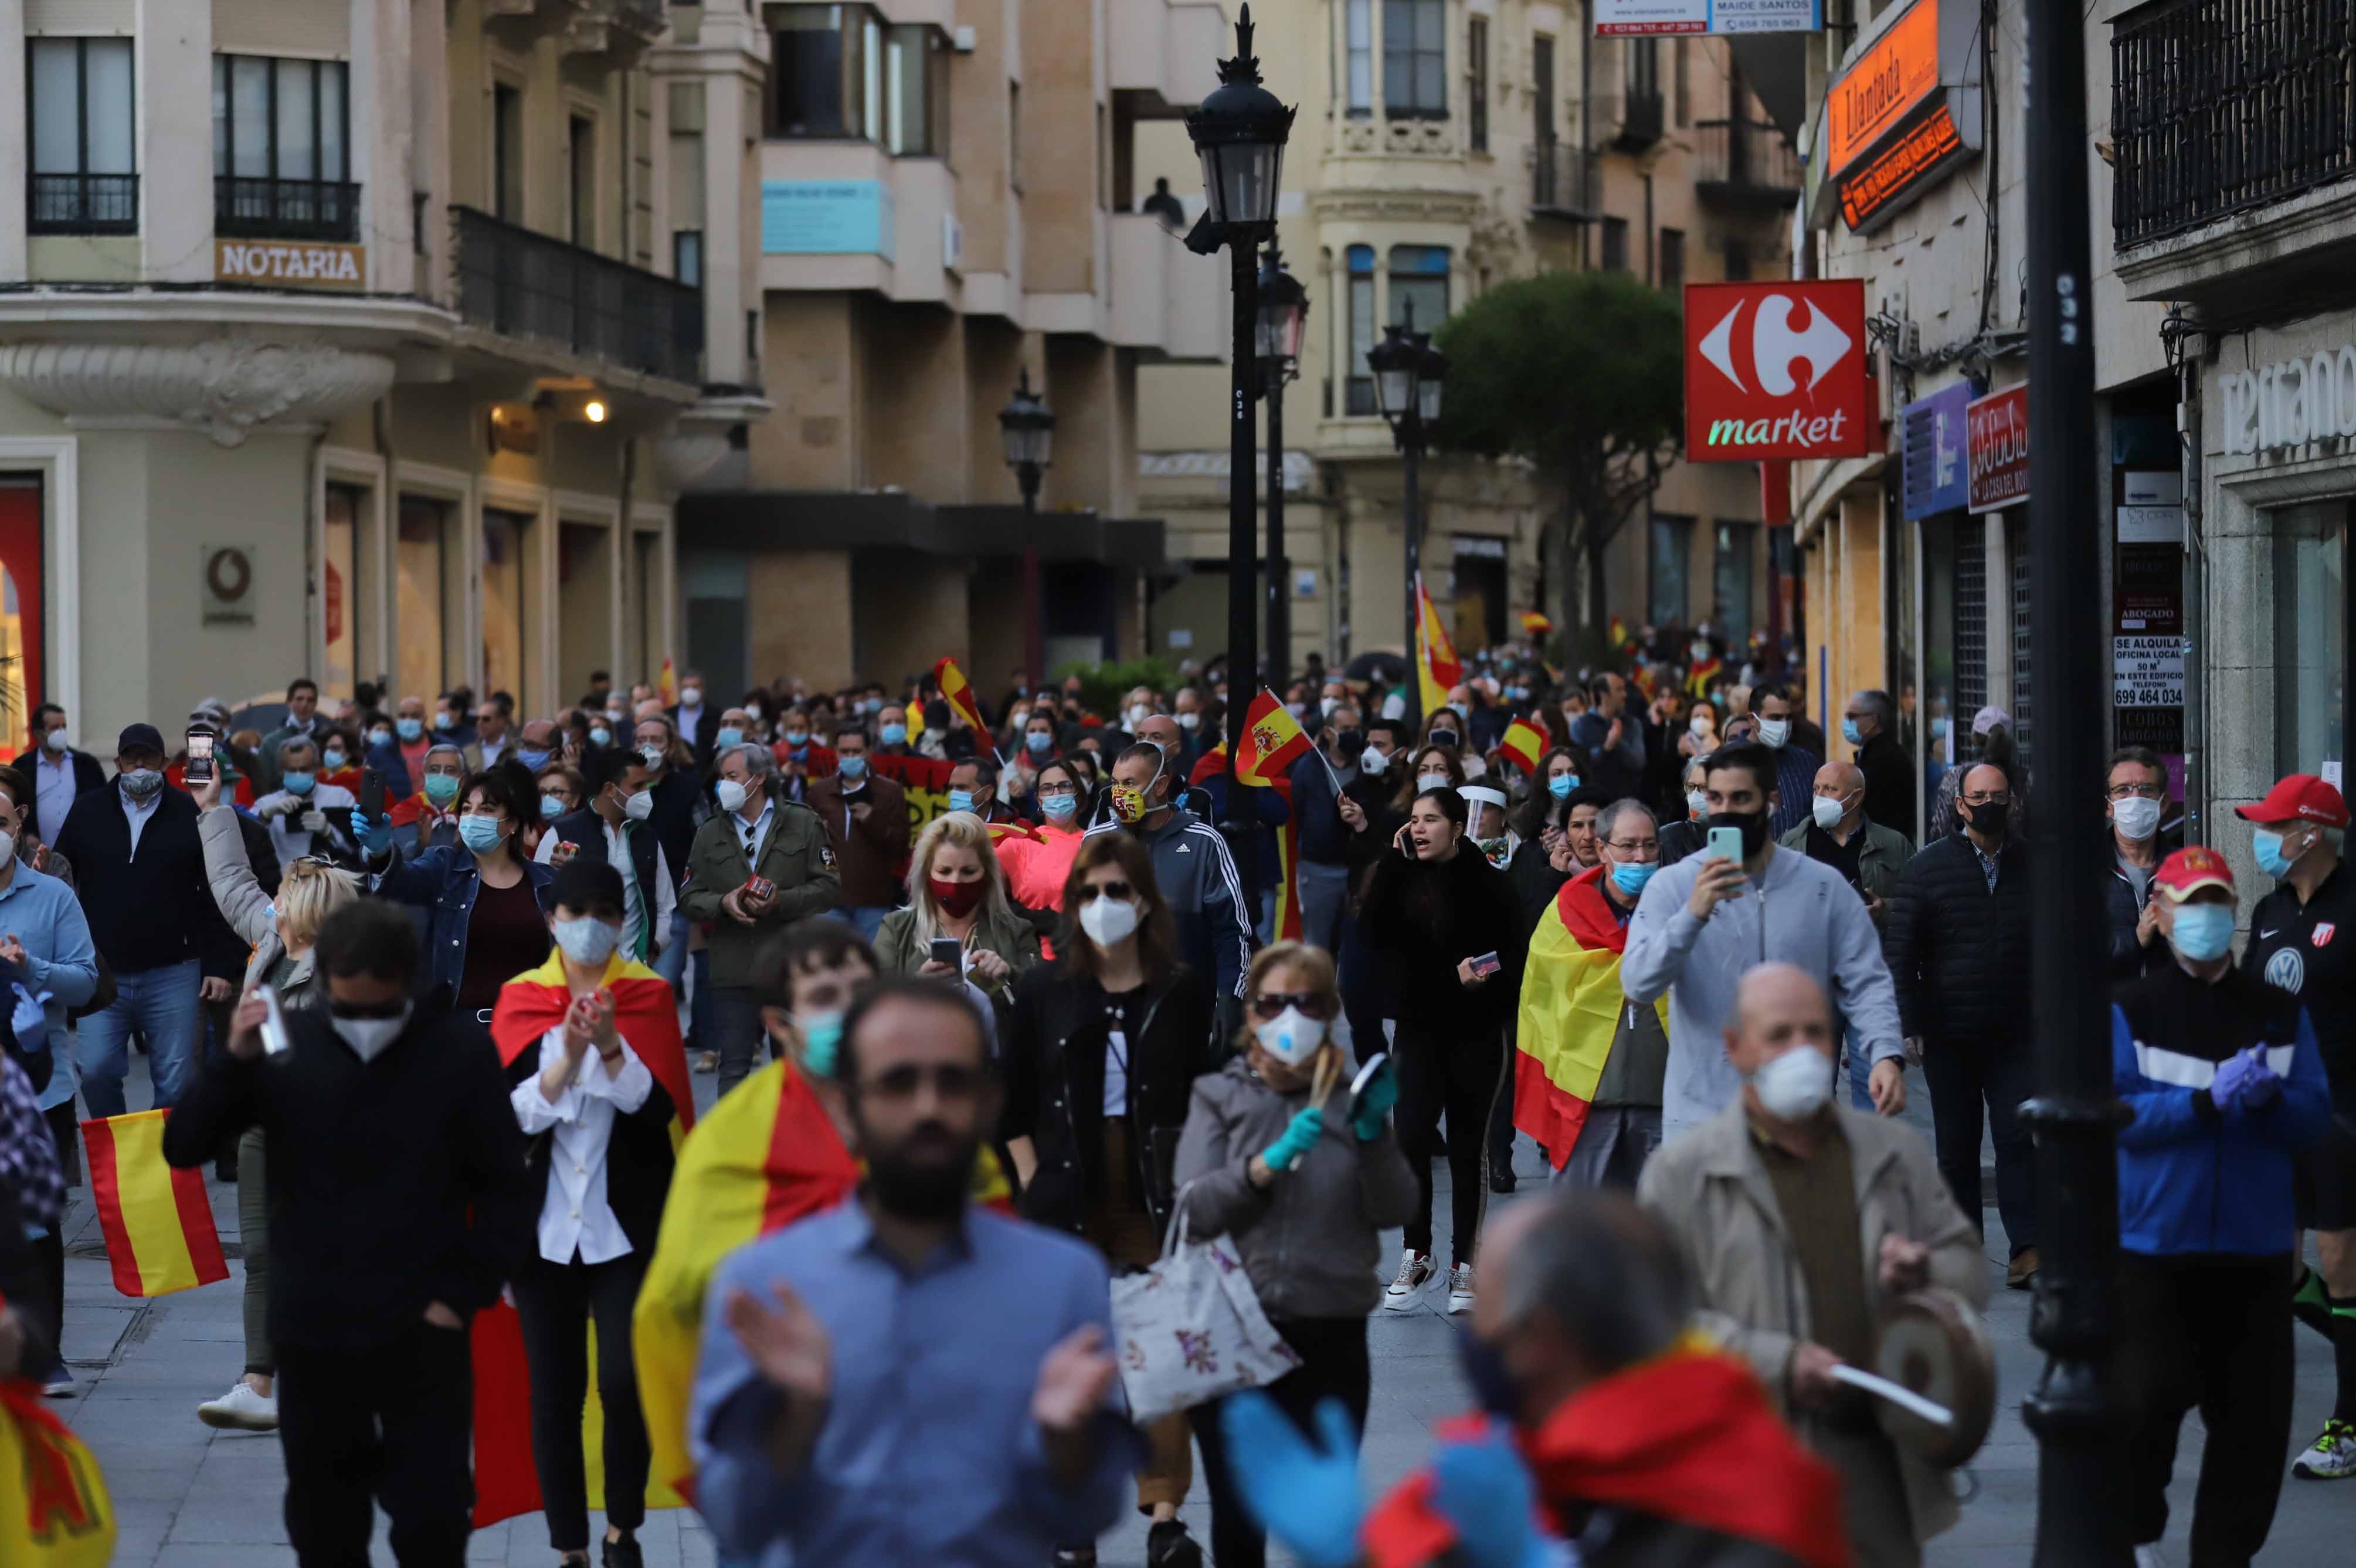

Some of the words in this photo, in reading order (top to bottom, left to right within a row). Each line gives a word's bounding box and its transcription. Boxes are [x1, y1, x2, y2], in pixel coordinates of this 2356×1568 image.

[1759, 1, 1810, 9] SANTOS
[1846, 47, 1900, 141] Llantada
[222, 245, 358, 280] NOTARIA
[1707, 408, 1847, 448] market
[2121, 609, 2174, 619] ABOGADO
[2116, 639, 2130, 649] SE
[2134, 638, 2181, 649] ALQUILA
[2137, 663, 2147, 671] 50
[2150, 672, 2184, 680] EDIFICIO
[2116, 690, 2136, 704] 699
[2139, 690, 2159, 704] 464
[2163, 689, 2182, 704] 034
